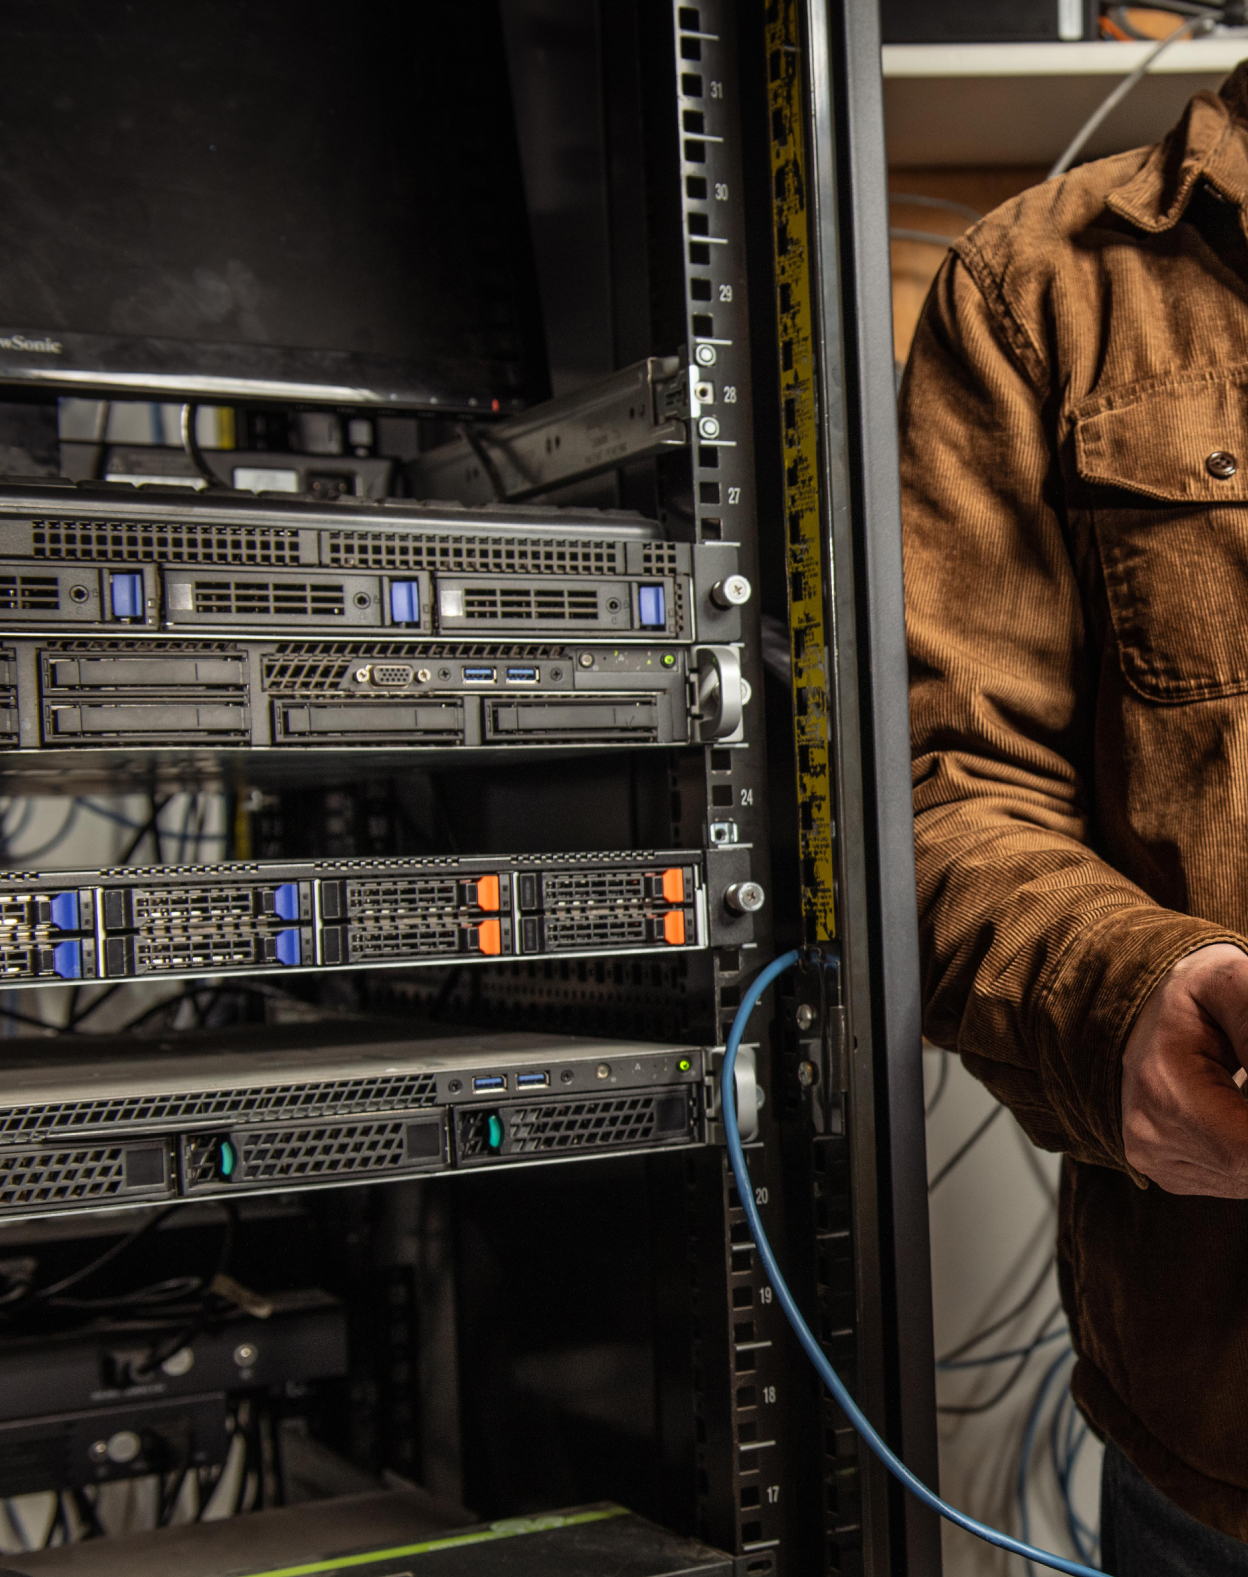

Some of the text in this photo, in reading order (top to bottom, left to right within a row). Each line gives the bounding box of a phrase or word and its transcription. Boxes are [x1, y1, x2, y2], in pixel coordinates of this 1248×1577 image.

[710, 81, 723, 99] 31
[714, 182, 729, 201] 30
[719, 284, 733, 302] 29
[723, 386, 737, 403] 28
[727, 486, 741, 505] 27
[740, 788, 753, 806] 24
[755, 1186, 769, 1205] 20
[759, 1286, 772, 1304] 19
[763, 1385, 776, 1404] 18
[766, 1484, 780, 1504] 17
